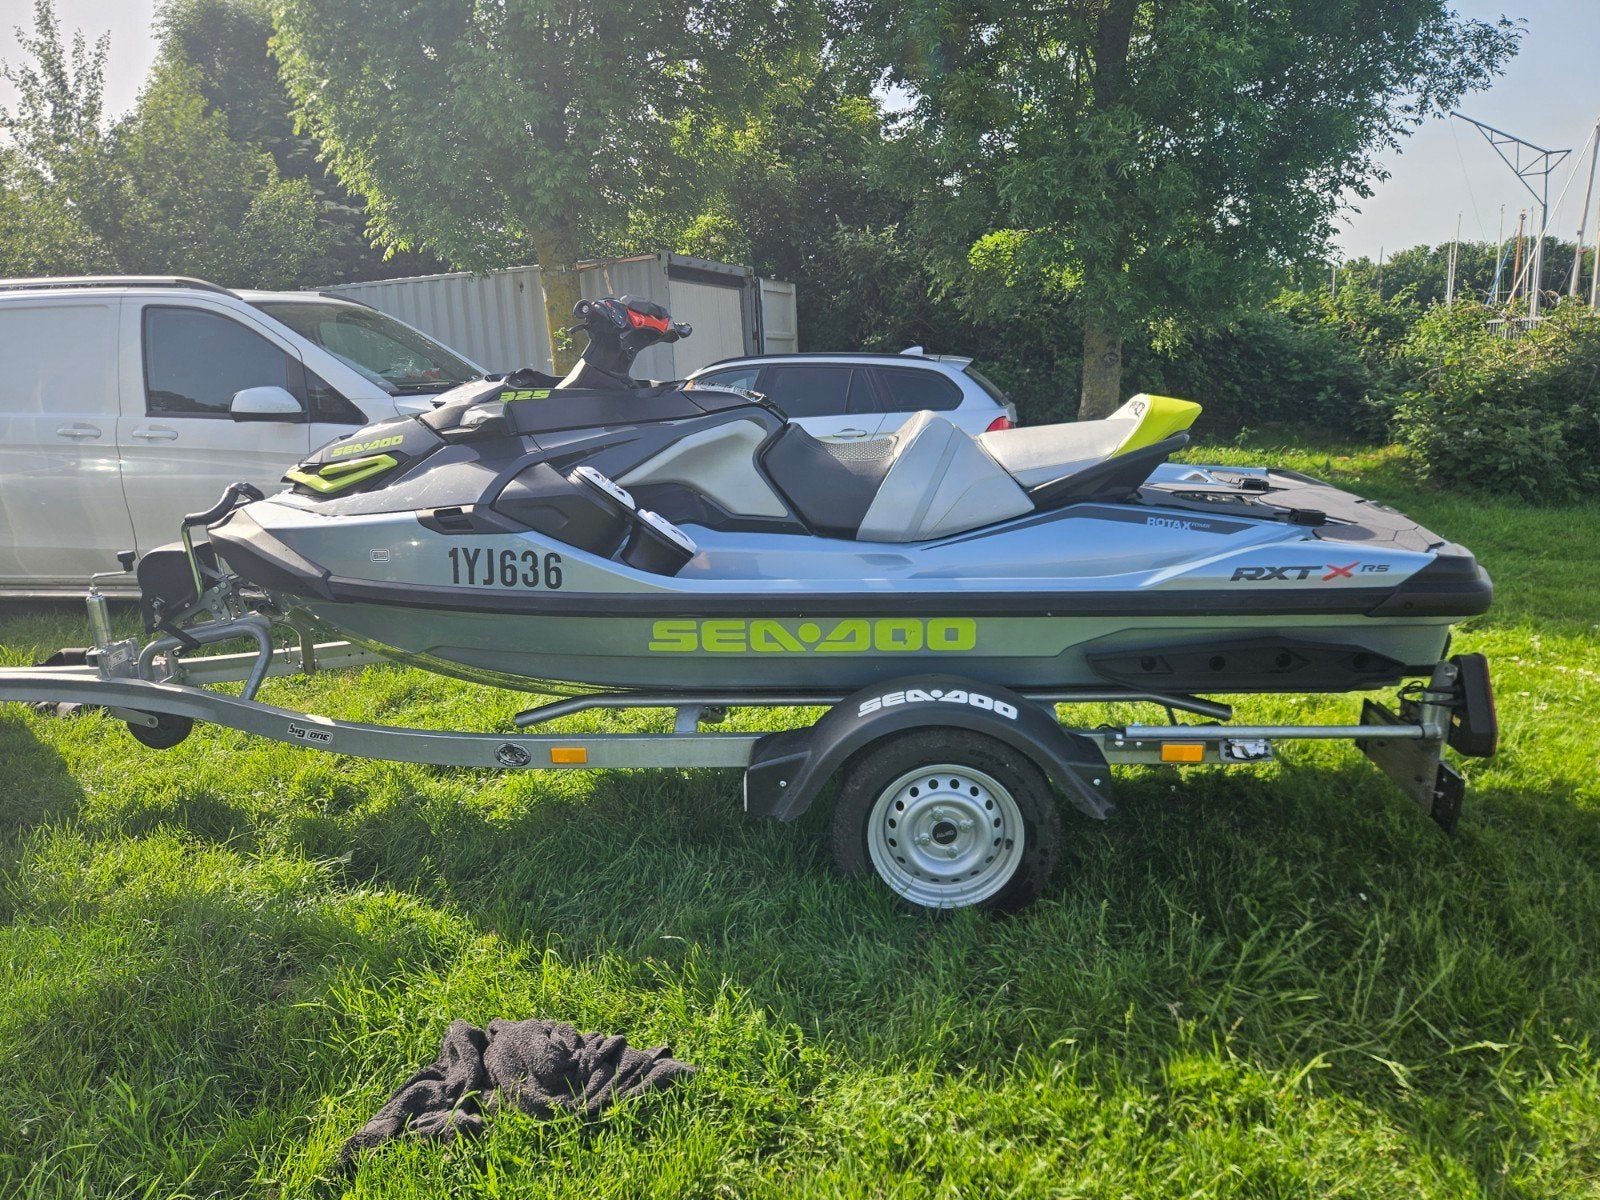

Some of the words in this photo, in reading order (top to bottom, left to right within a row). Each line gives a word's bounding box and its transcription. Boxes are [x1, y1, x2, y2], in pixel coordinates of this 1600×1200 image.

[500, 389, 550, 402] 325
[1146, 516, 1192, 531] ROTAX
[449, 547, 562, 590] 1YJ636
[1230, 565, 1323, 582] RXT
[1322, 561, 1361, 582] X
[1360, 564, 1391, 573] RS
[289, 723, 306, 738] big
[309, 731, 330, 741] one
